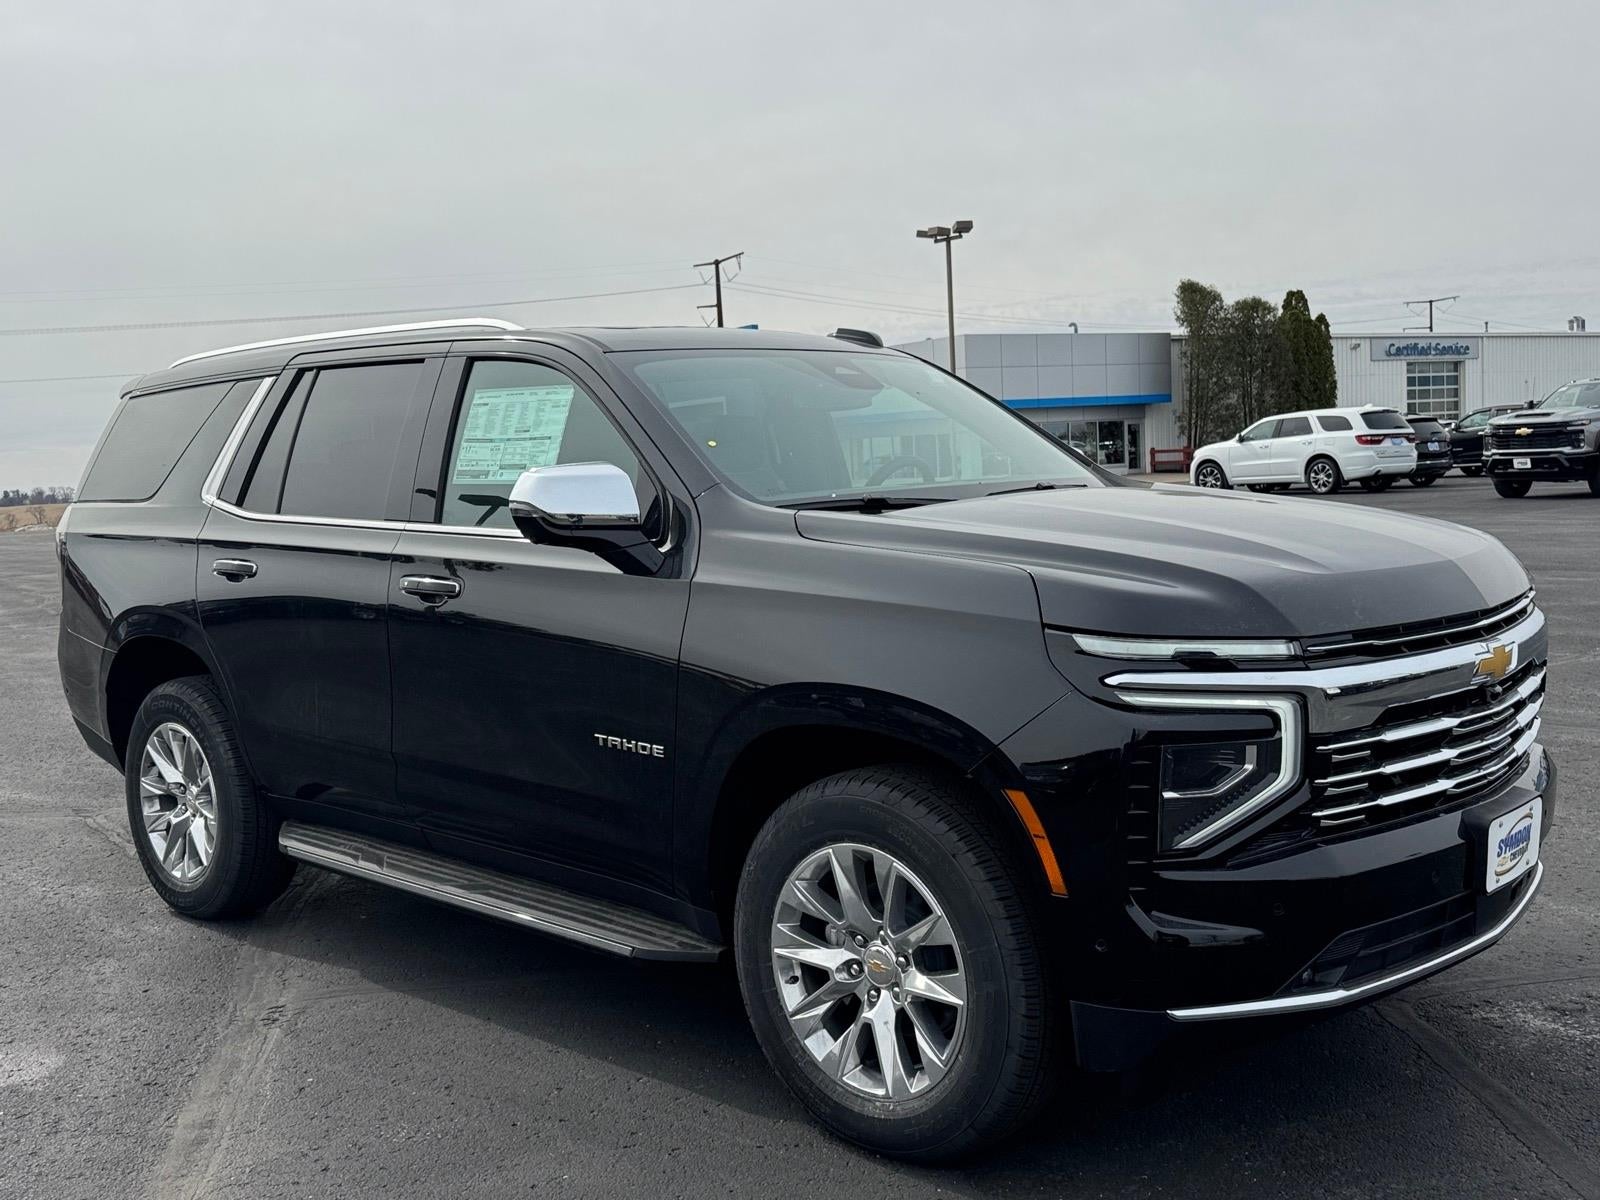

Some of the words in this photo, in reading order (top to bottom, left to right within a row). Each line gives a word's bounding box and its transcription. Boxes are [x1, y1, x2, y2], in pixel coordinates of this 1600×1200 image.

[1385, 342, 1431, 357] Certified
[1432, 342, 1470, 356] Service
[594, 733, 664, 758] TAHOE
